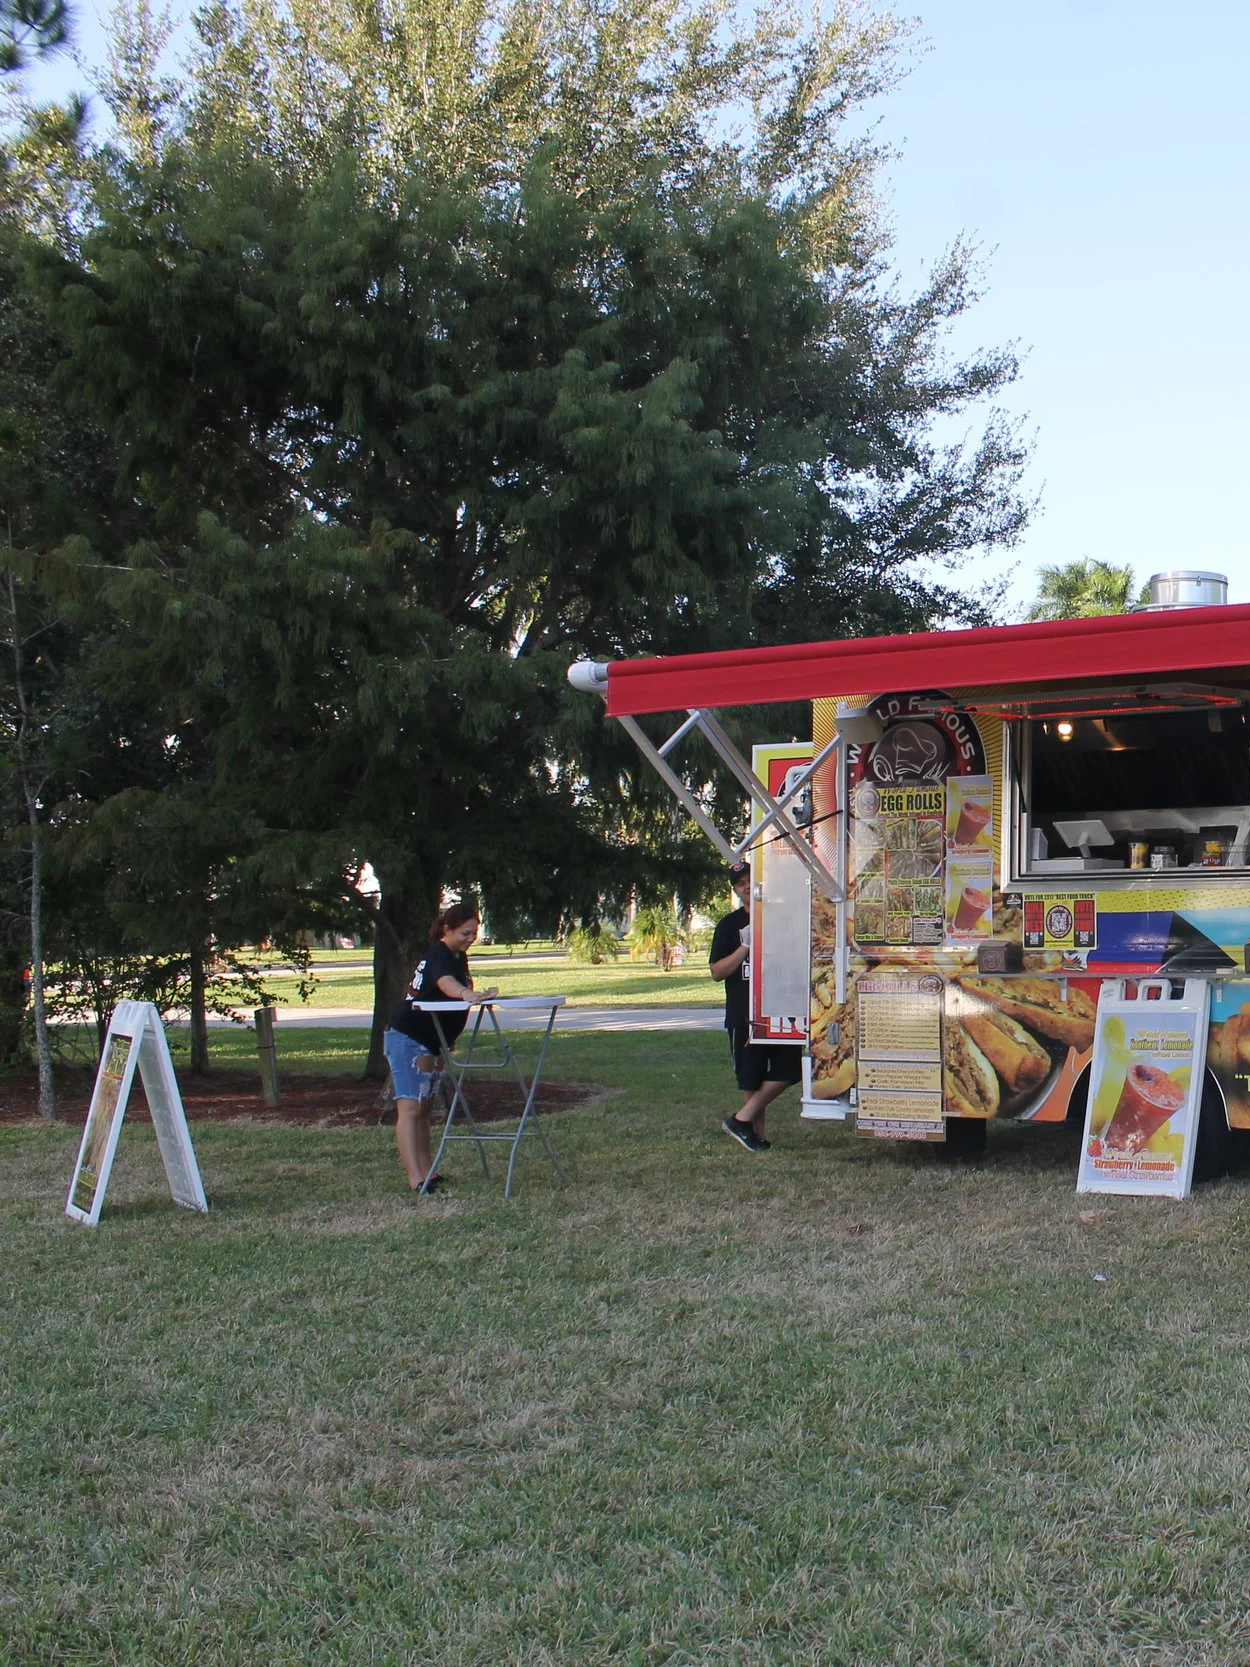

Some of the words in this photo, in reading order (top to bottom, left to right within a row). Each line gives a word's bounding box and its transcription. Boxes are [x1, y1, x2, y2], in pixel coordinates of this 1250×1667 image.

[880, 794, 904, 812] EGG
[906, 793, 942, 811] ROLLS
[1130, 1038, 1158, 1051] Southern
[1160, 1038, 1194, 1050] Lemonade
[1094, 1160, 1134, 1170] Strawberry
[1138, 1161, 1175, 1171] Lemonade
